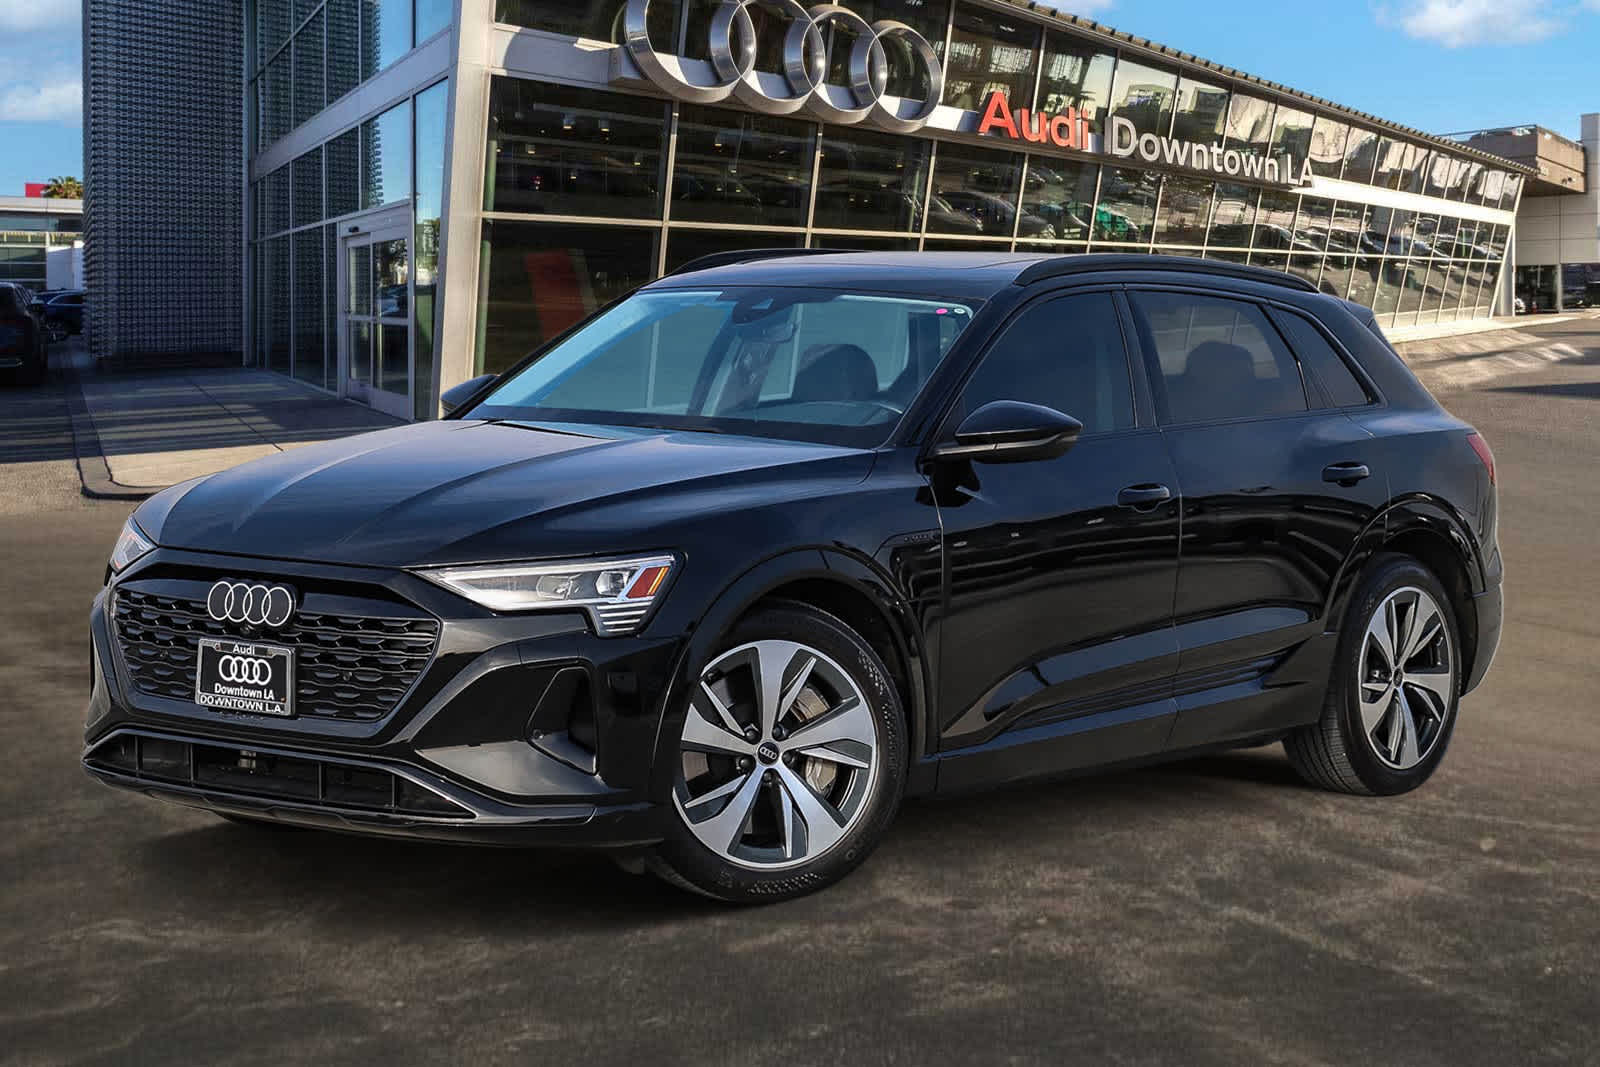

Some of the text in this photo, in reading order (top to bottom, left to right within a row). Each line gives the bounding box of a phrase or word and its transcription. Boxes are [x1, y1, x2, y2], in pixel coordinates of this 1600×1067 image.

[978, 91, 1315, 188] Audi Downtown LA
[232, 644, 255, 655] Audi
[214, 683, 274, 700] Downtown LA
[200, 695, 263, 711] DOWNTOWN
